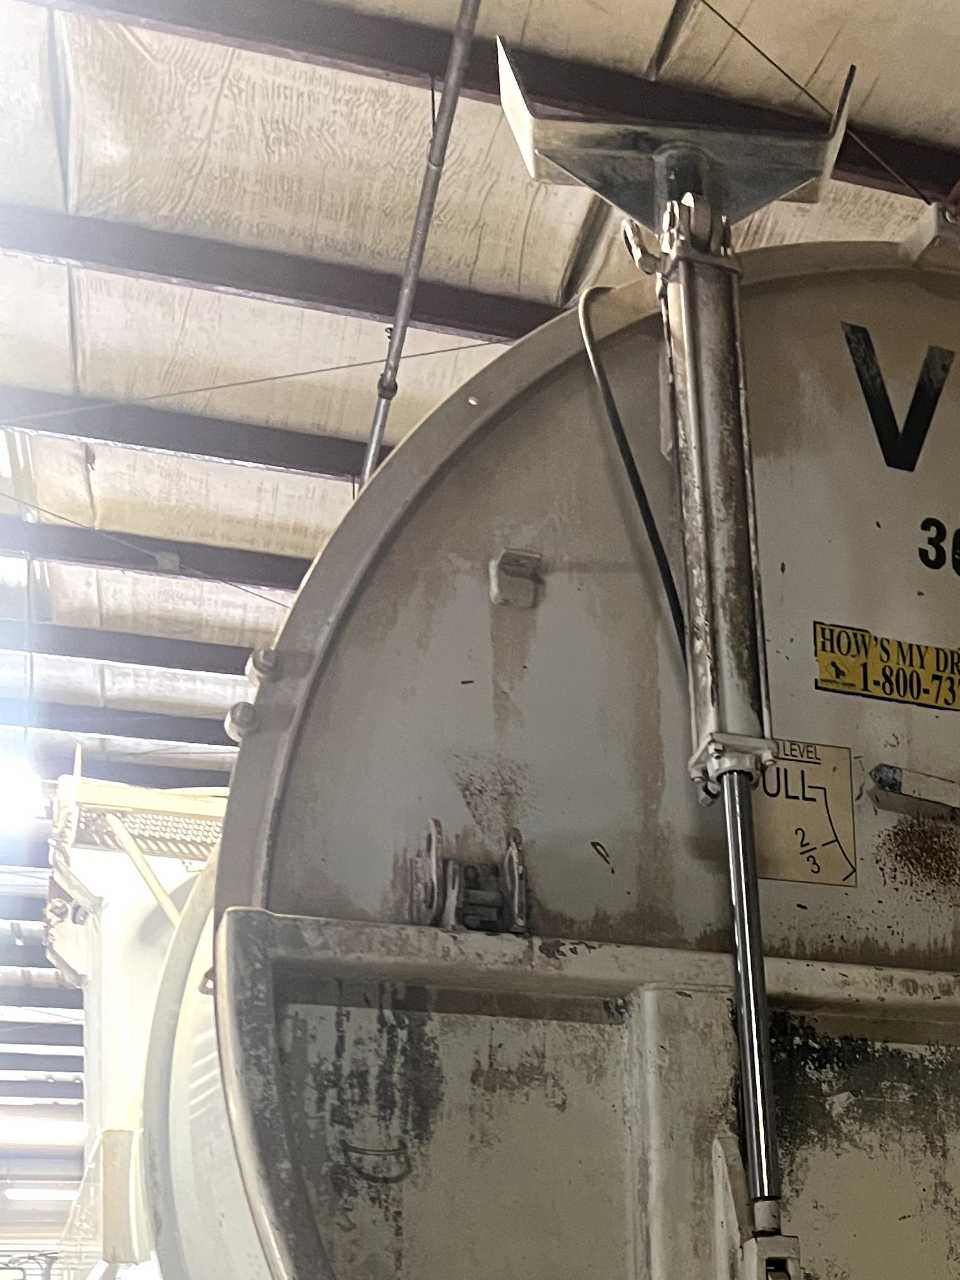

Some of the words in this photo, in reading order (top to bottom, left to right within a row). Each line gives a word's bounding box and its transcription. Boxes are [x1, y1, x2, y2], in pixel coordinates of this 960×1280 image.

[820, 627, 890, 664] HOW'S
[896, 640, 928, 670] MY
[782, 741, 822, 761] LEVEL
[762, 766, 817, 802] ULL
